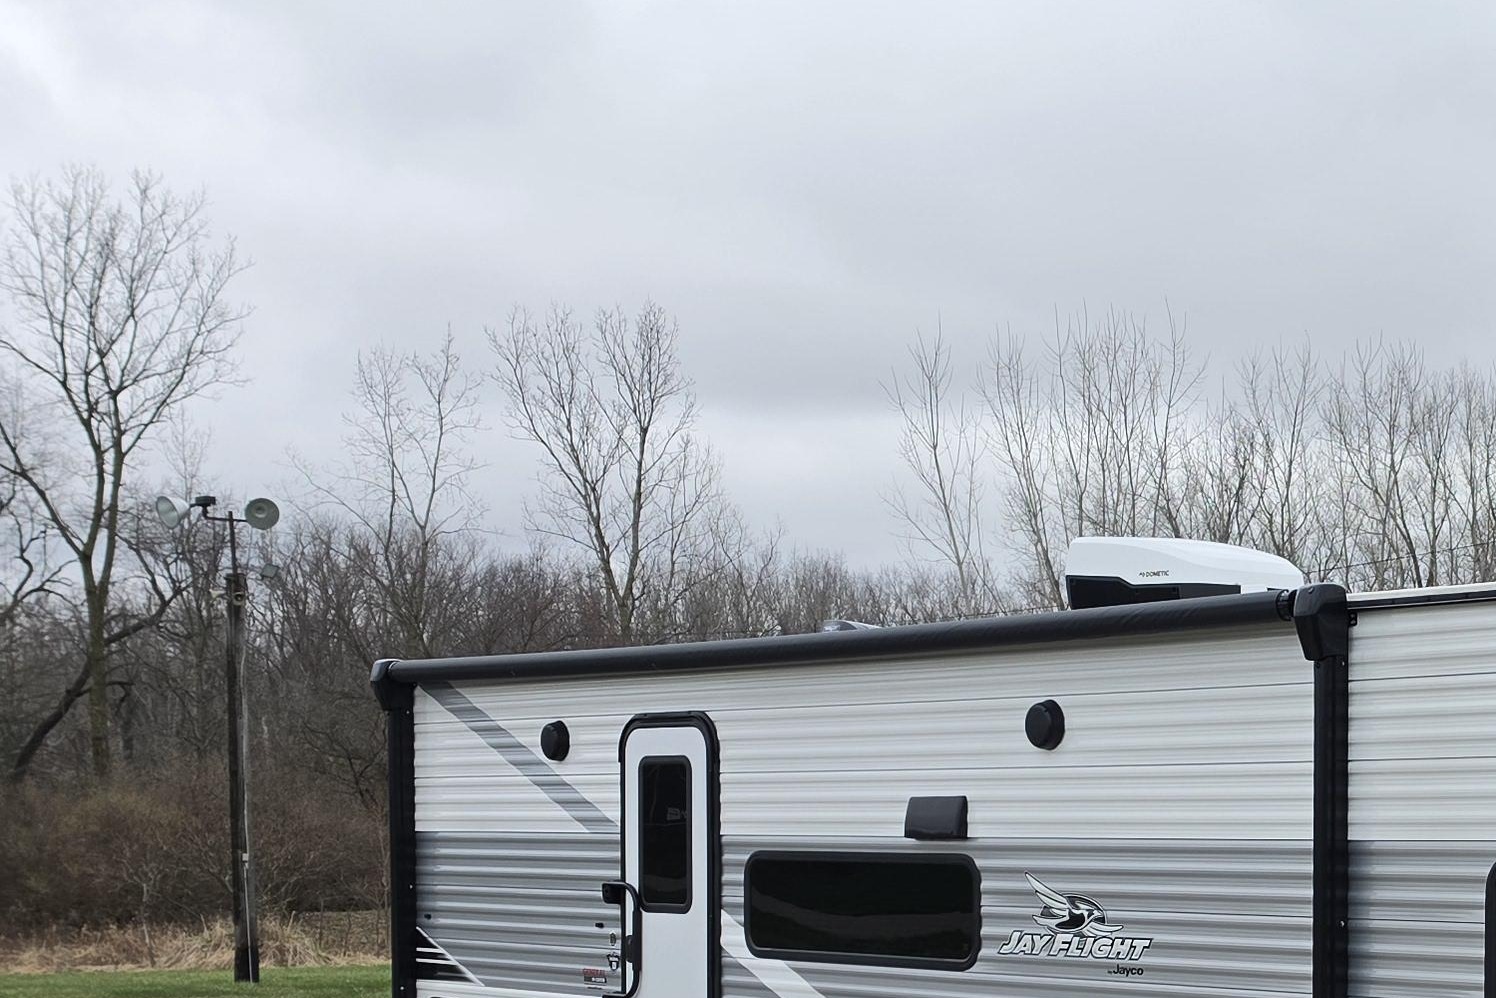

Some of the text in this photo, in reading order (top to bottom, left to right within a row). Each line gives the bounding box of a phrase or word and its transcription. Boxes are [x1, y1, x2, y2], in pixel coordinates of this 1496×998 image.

[998, 930, 1154, 961] JAY FLIGHT
[1112, 963, 1144, 978] Jayco
